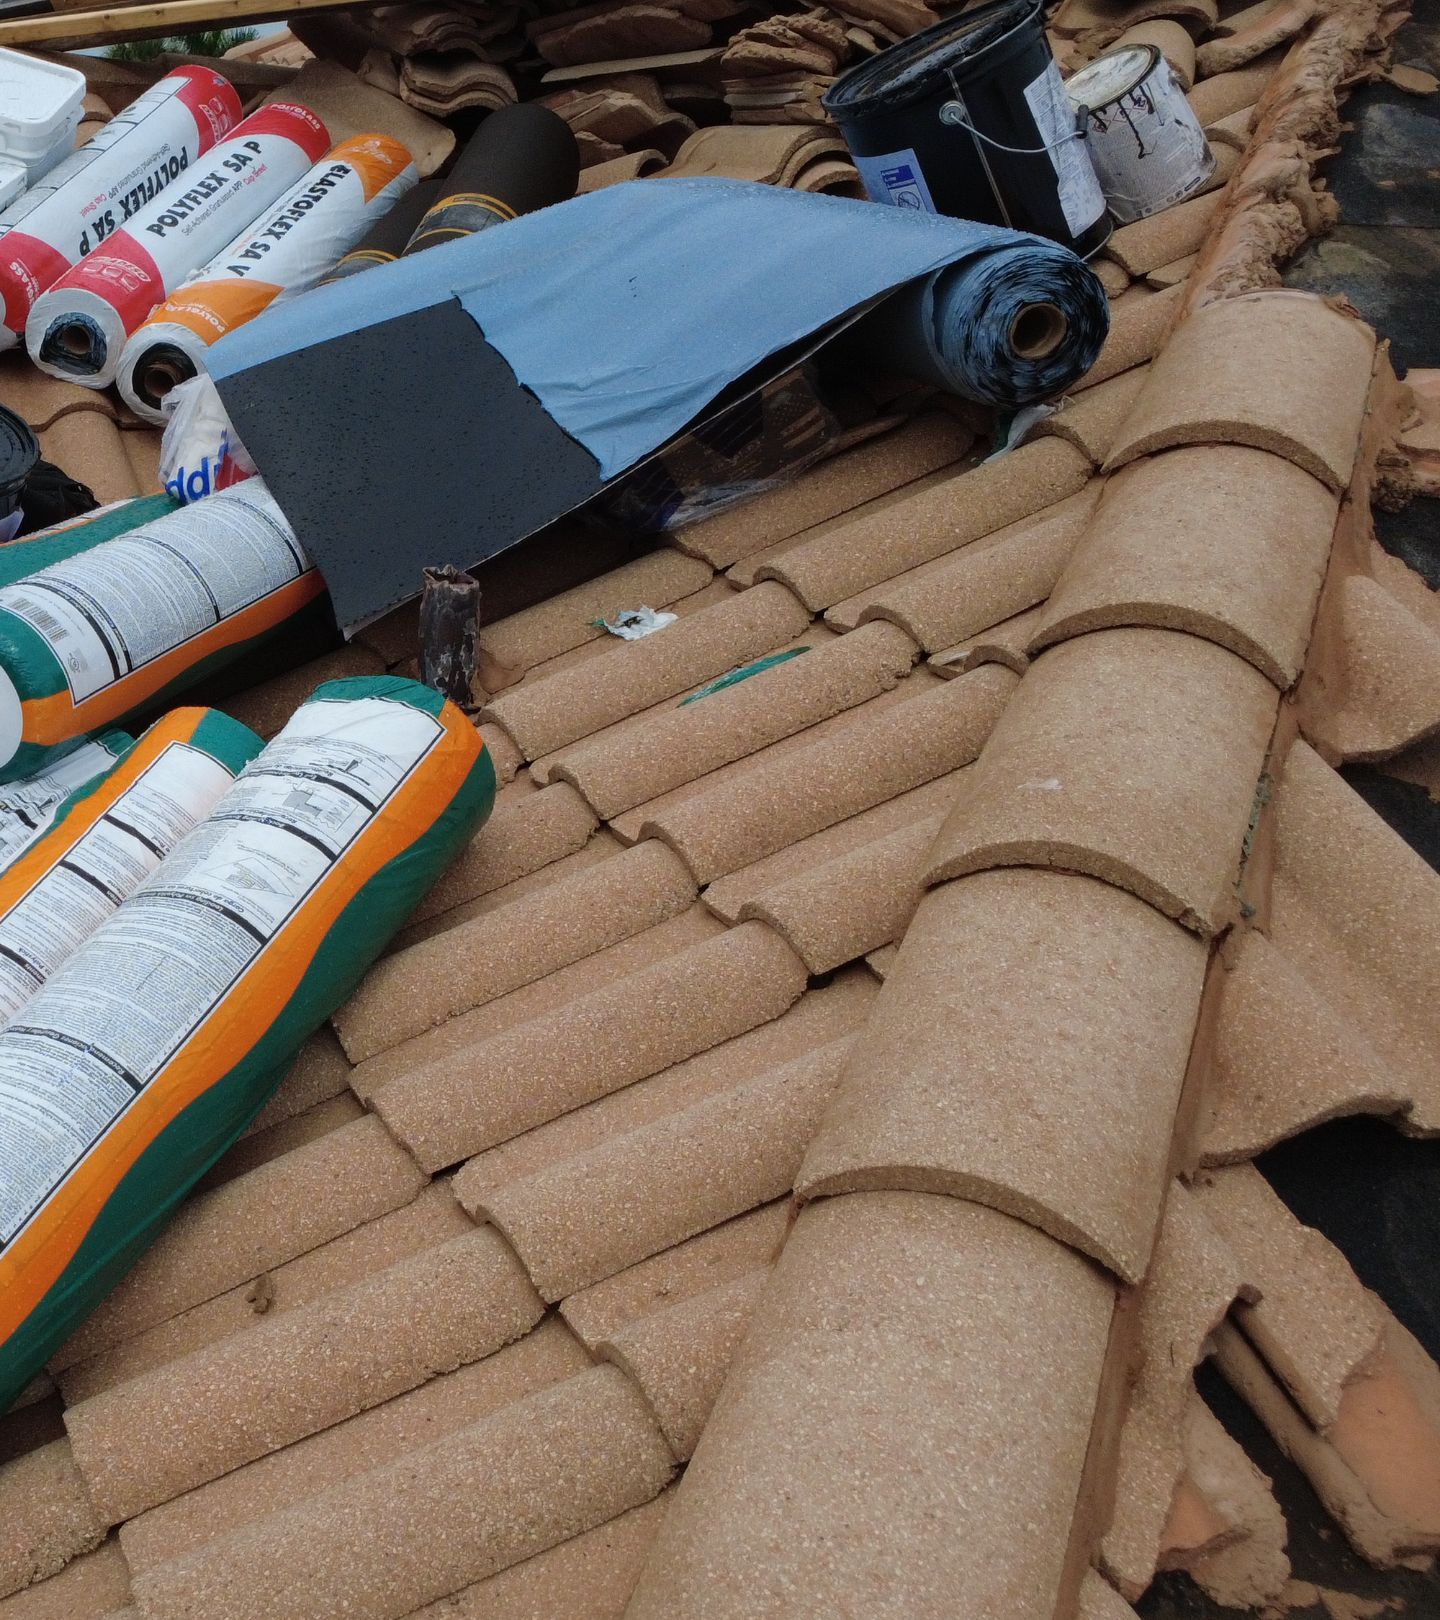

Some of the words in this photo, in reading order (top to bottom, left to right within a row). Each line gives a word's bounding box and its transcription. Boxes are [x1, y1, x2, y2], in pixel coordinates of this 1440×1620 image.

[119, 146, 188, 221] POLYFLEX
[146, 172, 230, 238] POLYFLEX
[222, 153, 254, 173] SA
[243, 140, 263, 155] P
[261, 164, 352, 241] ELASTOFLEX
[92, 210, 116, 241] SA
[79, 230, 91, 257] P
[238, 241, 271, 261] SA
[226, 264, 252, 277] V
